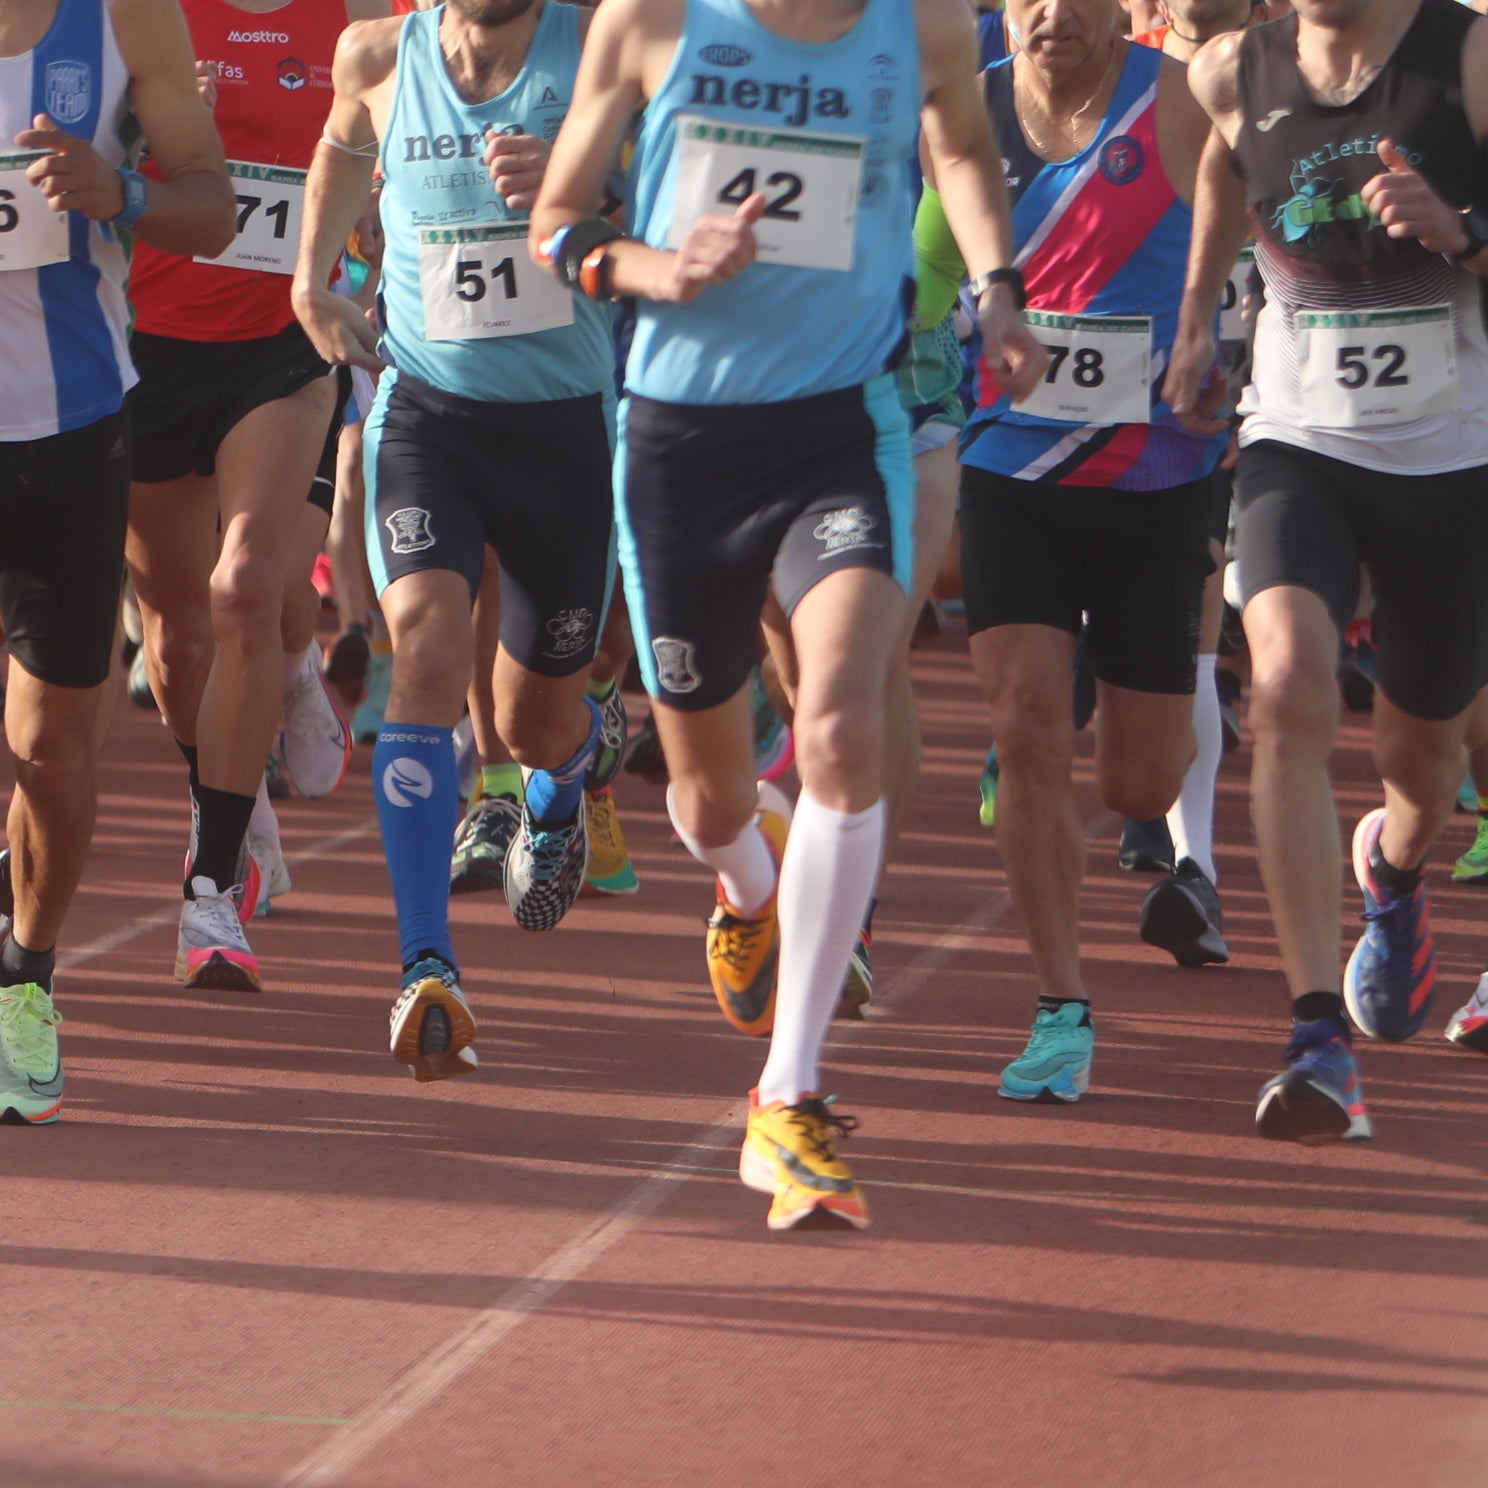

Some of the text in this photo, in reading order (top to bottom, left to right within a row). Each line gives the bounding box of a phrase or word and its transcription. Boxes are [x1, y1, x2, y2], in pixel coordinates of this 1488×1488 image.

[688, 73, 851, 127] nerja
[1299, 134, 1423, 176] Atletimo
[422, 170, 488, 190] ATLETIS
[717, 166, 805, 223] 42
[236, 194, 289, 240] 71
[235, 252, 282, 265] JUAN MORENO
[455, 257, 518, 303] 51
[1041, 344, 1104, 388] 78
[1335, 344, 1409, 390] 52
